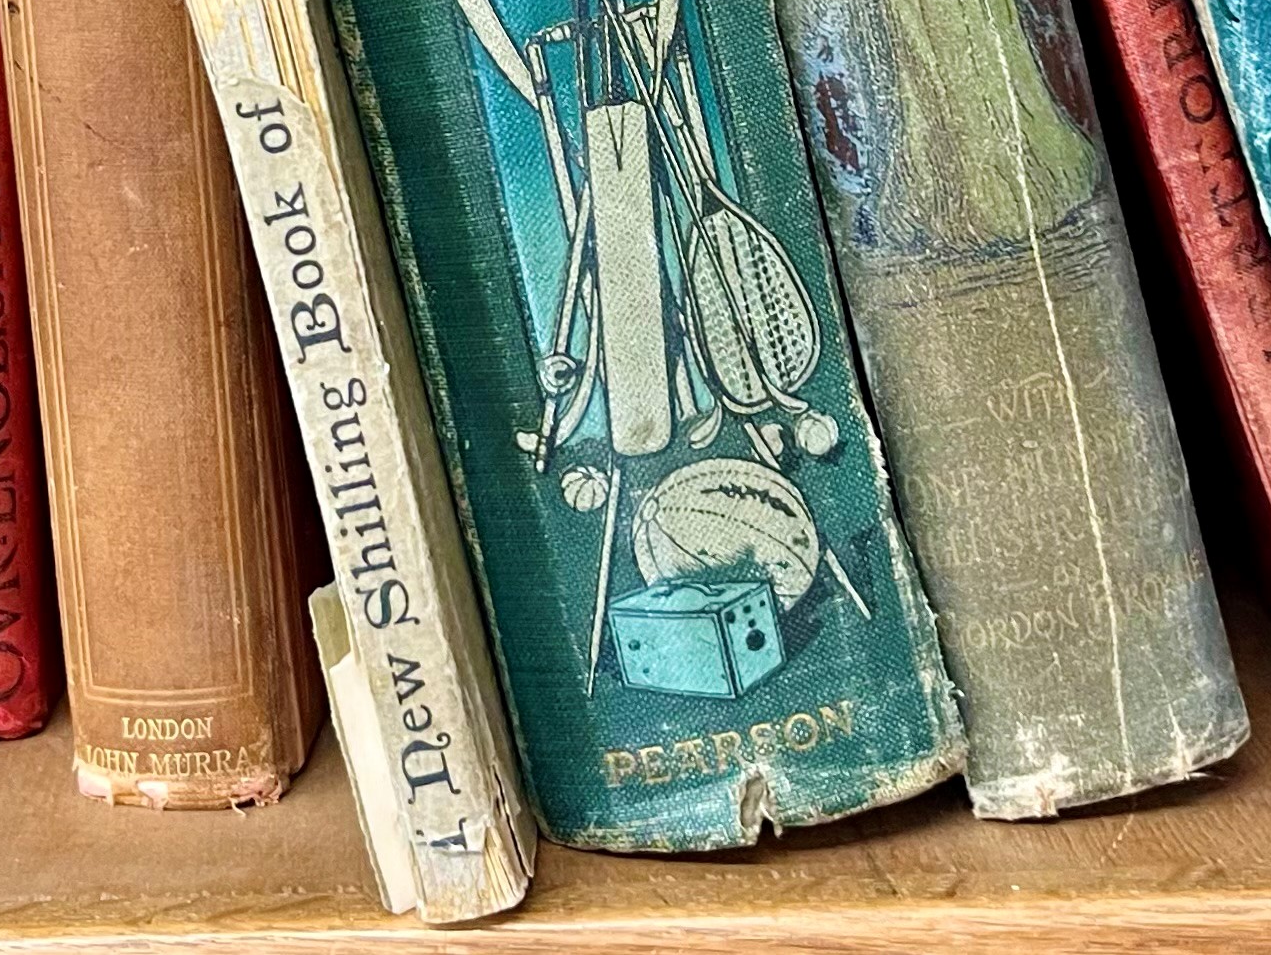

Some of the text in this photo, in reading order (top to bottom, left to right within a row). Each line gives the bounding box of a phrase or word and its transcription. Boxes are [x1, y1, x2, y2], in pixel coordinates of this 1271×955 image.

[236, 98, 292, 155] of
[265, 182, 352, 365] Book
[320, 377, 420, 629] Shilling
[122, 717, 213, 740] LONDON
[150, 746, 252, 777] MURRA
[387, 654, 461, 805] New
[603, 700, 857, 787] PEARSON
